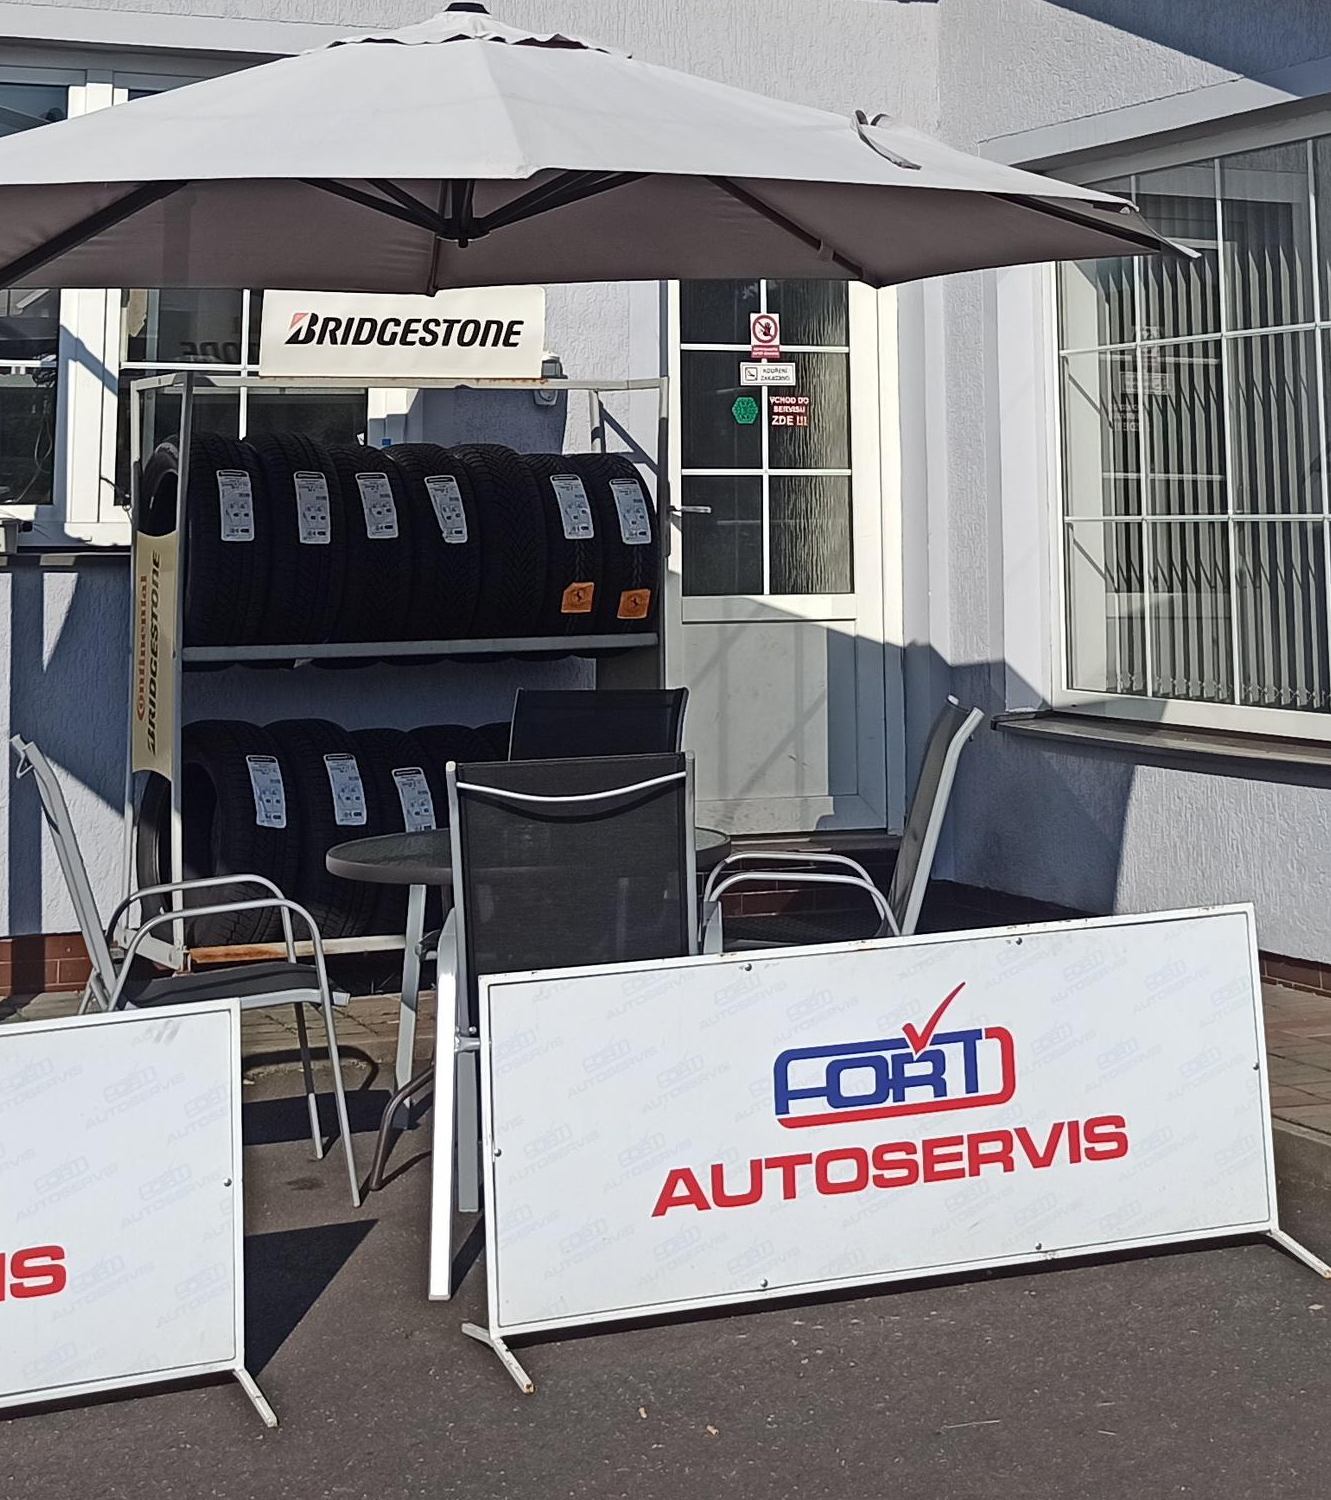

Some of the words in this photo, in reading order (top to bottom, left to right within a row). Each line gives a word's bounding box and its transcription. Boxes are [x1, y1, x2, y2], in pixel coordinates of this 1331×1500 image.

[284, 312, 525, 348] BRIDGESTONE
[769, 396, 796, 405] VCHOD
[798, 397, 809, 405] DO
[771, 415, 794, 425] ZDE
[146, 550, 161, 757] BRIDGESTONE
[773, 1026, 1015, 1129] FORT
[651, 1115, 1129, 1217] AUTOSERVIS
